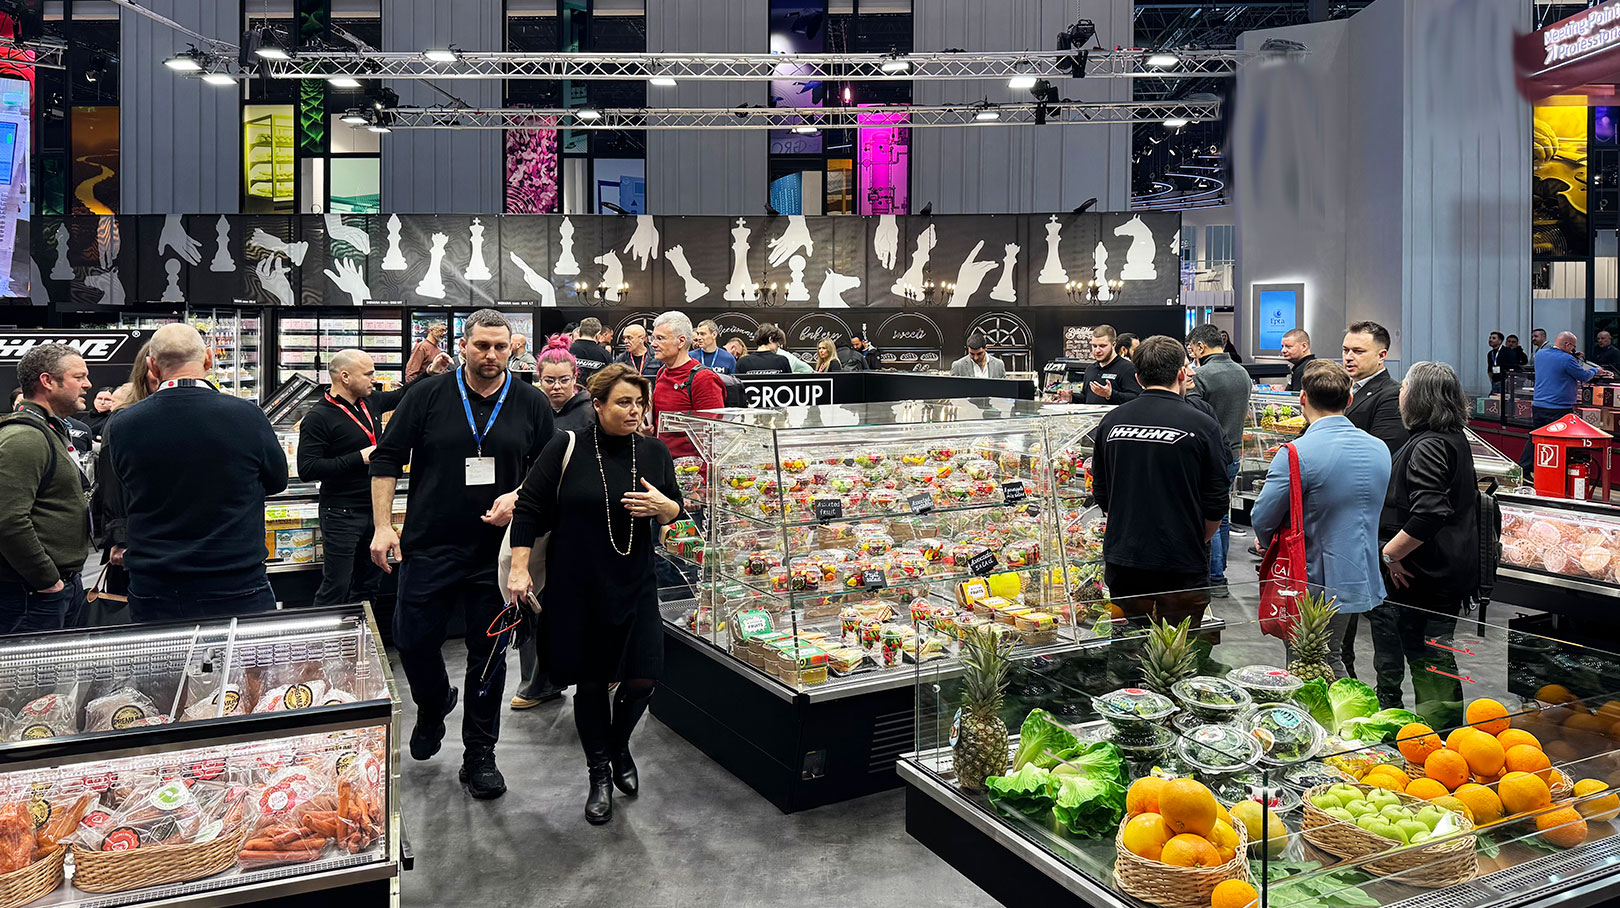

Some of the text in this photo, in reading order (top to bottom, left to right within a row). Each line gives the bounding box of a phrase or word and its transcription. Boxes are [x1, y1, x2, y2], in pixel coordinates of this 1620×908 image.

[1544, 18, 1587, 46] Meeting
[744, 385, 823, 408] GROUP
[1582, 438, 1592, 447] 15
[1274, 563, 1291, 577] CA
